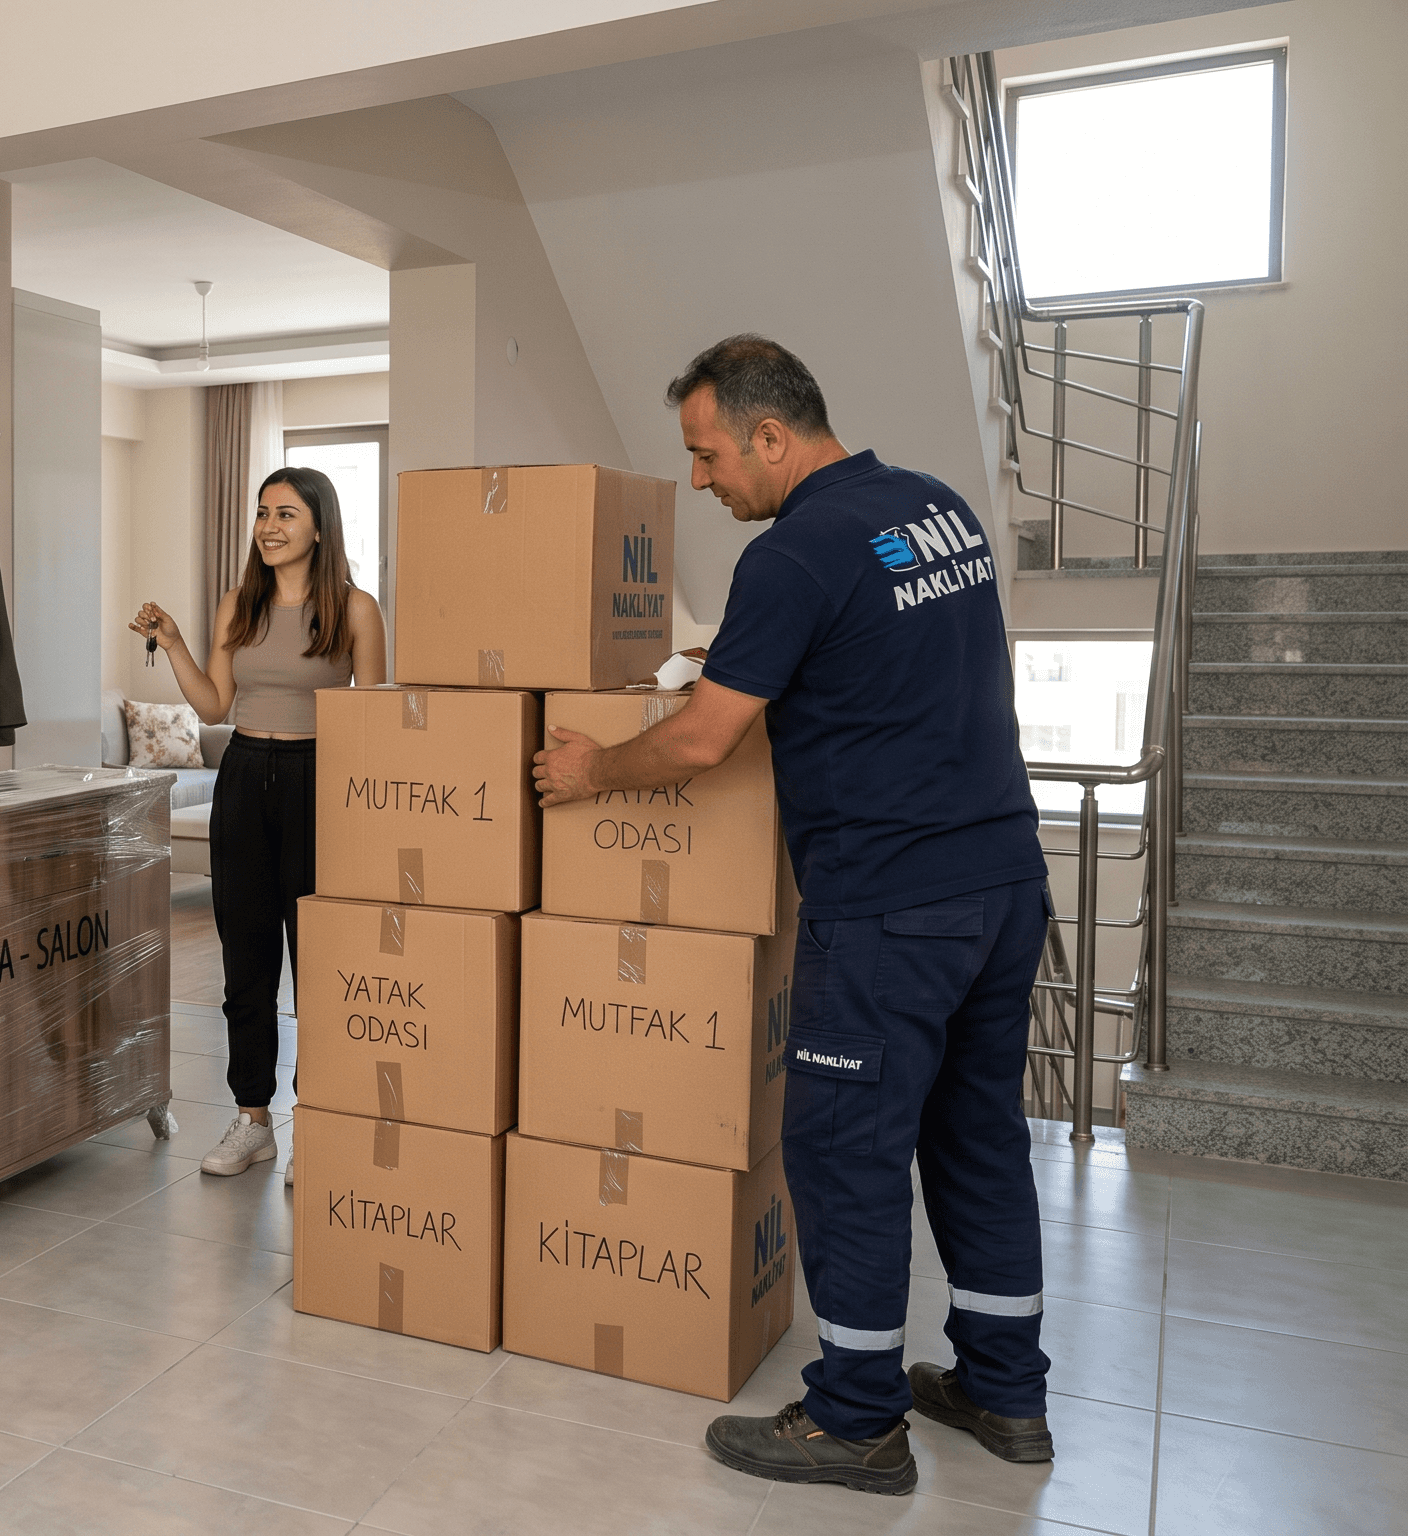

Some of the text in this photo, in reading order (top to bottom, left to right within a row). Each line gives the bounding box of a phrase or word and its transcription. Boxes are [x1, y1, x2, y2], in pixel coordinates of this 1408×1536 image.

[622, 523, 658, 583] NİL
[904, 503, 983, 562] NİL
[612, 586, 665, 618] NAKLİYAT
[893, 556, 994, 611] NAKLİYAT
[345, 776, 493, 822] MUTFAK 1
[593, 819, 691, 855] ODASI
[19, 953, 30, 961] -
[36, 909, 109, 970] SALON
[336, 969, 426, 1010] YATAK
[767, 974, 789, 1054] Nİ
[346, 1013, 427, 1051] ODASI
[561, 996, 726, 1051] MUTFAK 1
[796, 1048, 811, 1062] NİL
[329, 1189, 462, 1252] KİTAPLAR
[753, 1193, 787, 1278] NİL
[539, 1219, 711, 1300] KİTAPLAR
